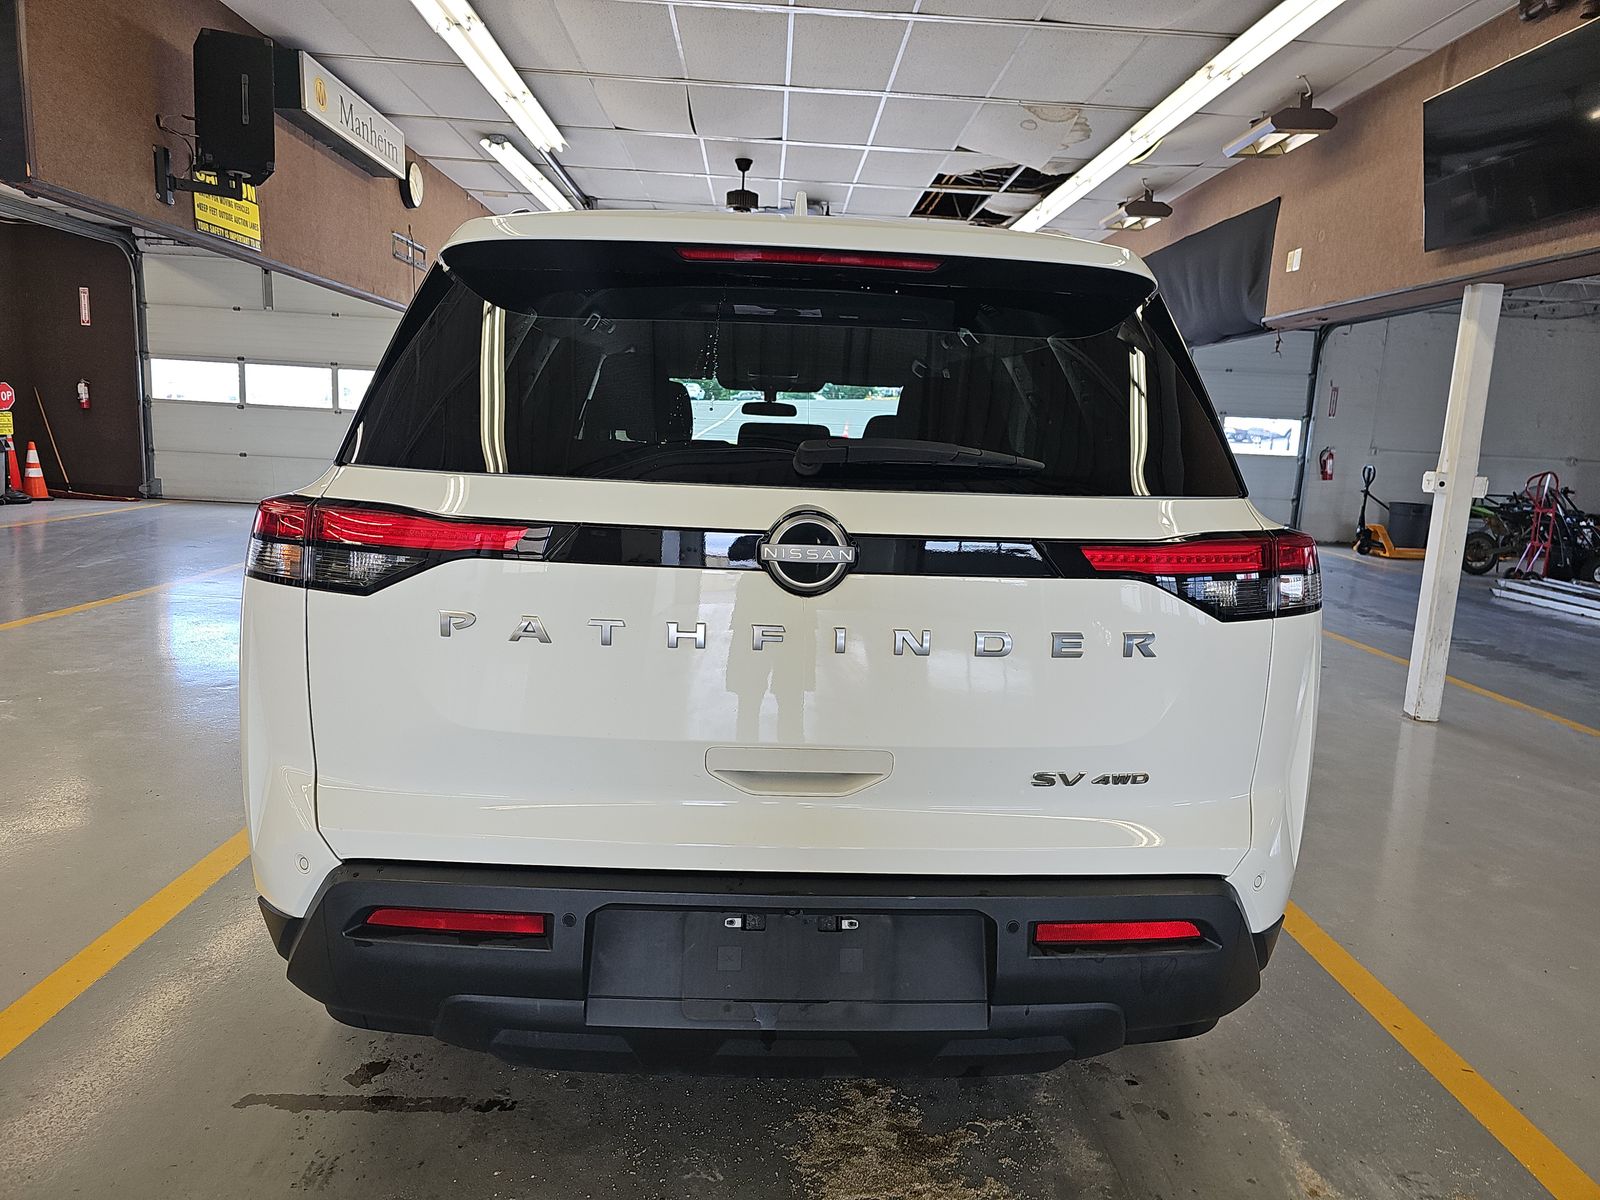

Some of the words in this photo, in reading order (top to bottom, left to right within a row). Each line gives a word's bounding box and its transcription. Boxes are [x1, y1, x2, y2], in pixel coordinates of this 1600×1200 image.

[339, 94, 398, 164] Manheim
[0, 391, 12, 401] OP
[764, 547, 852, 561] NISSAN
[438, 609, 1157, 658] PATHFINDER
[1031, 772, 1087, 787] SV
[1091, 772, 1150, 785] 4WD
